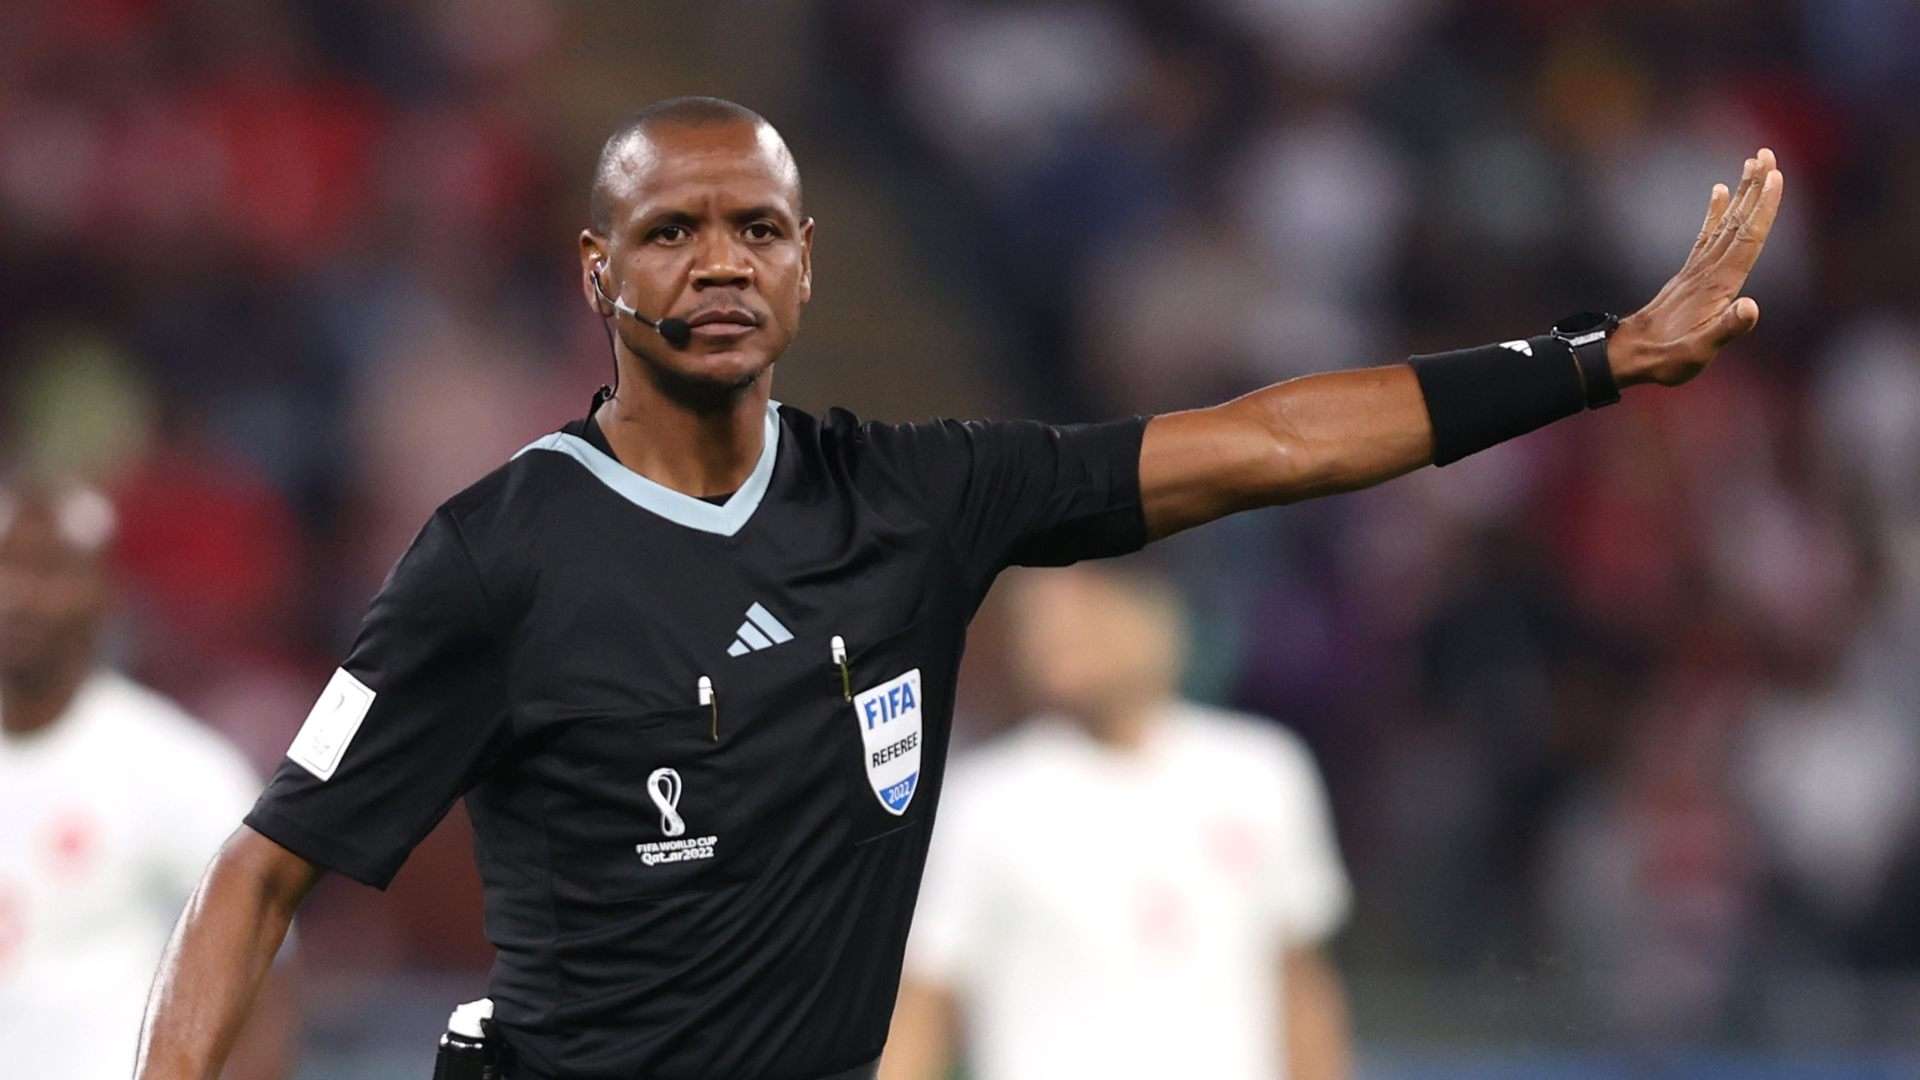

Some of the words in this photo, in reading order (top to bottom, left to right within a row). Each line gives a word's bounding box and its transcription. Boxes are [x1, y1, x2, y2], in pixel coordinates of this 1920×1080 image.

[864, 681, 916, 730] FIFA
[872, 732, 918, 768] REFEREE
[888, 781, 911, 805] 2022
[636, 843, 659, 854] FIFA
[659, 839, 697, 851] WORLD
[697, 836, 718, 846] CUP
